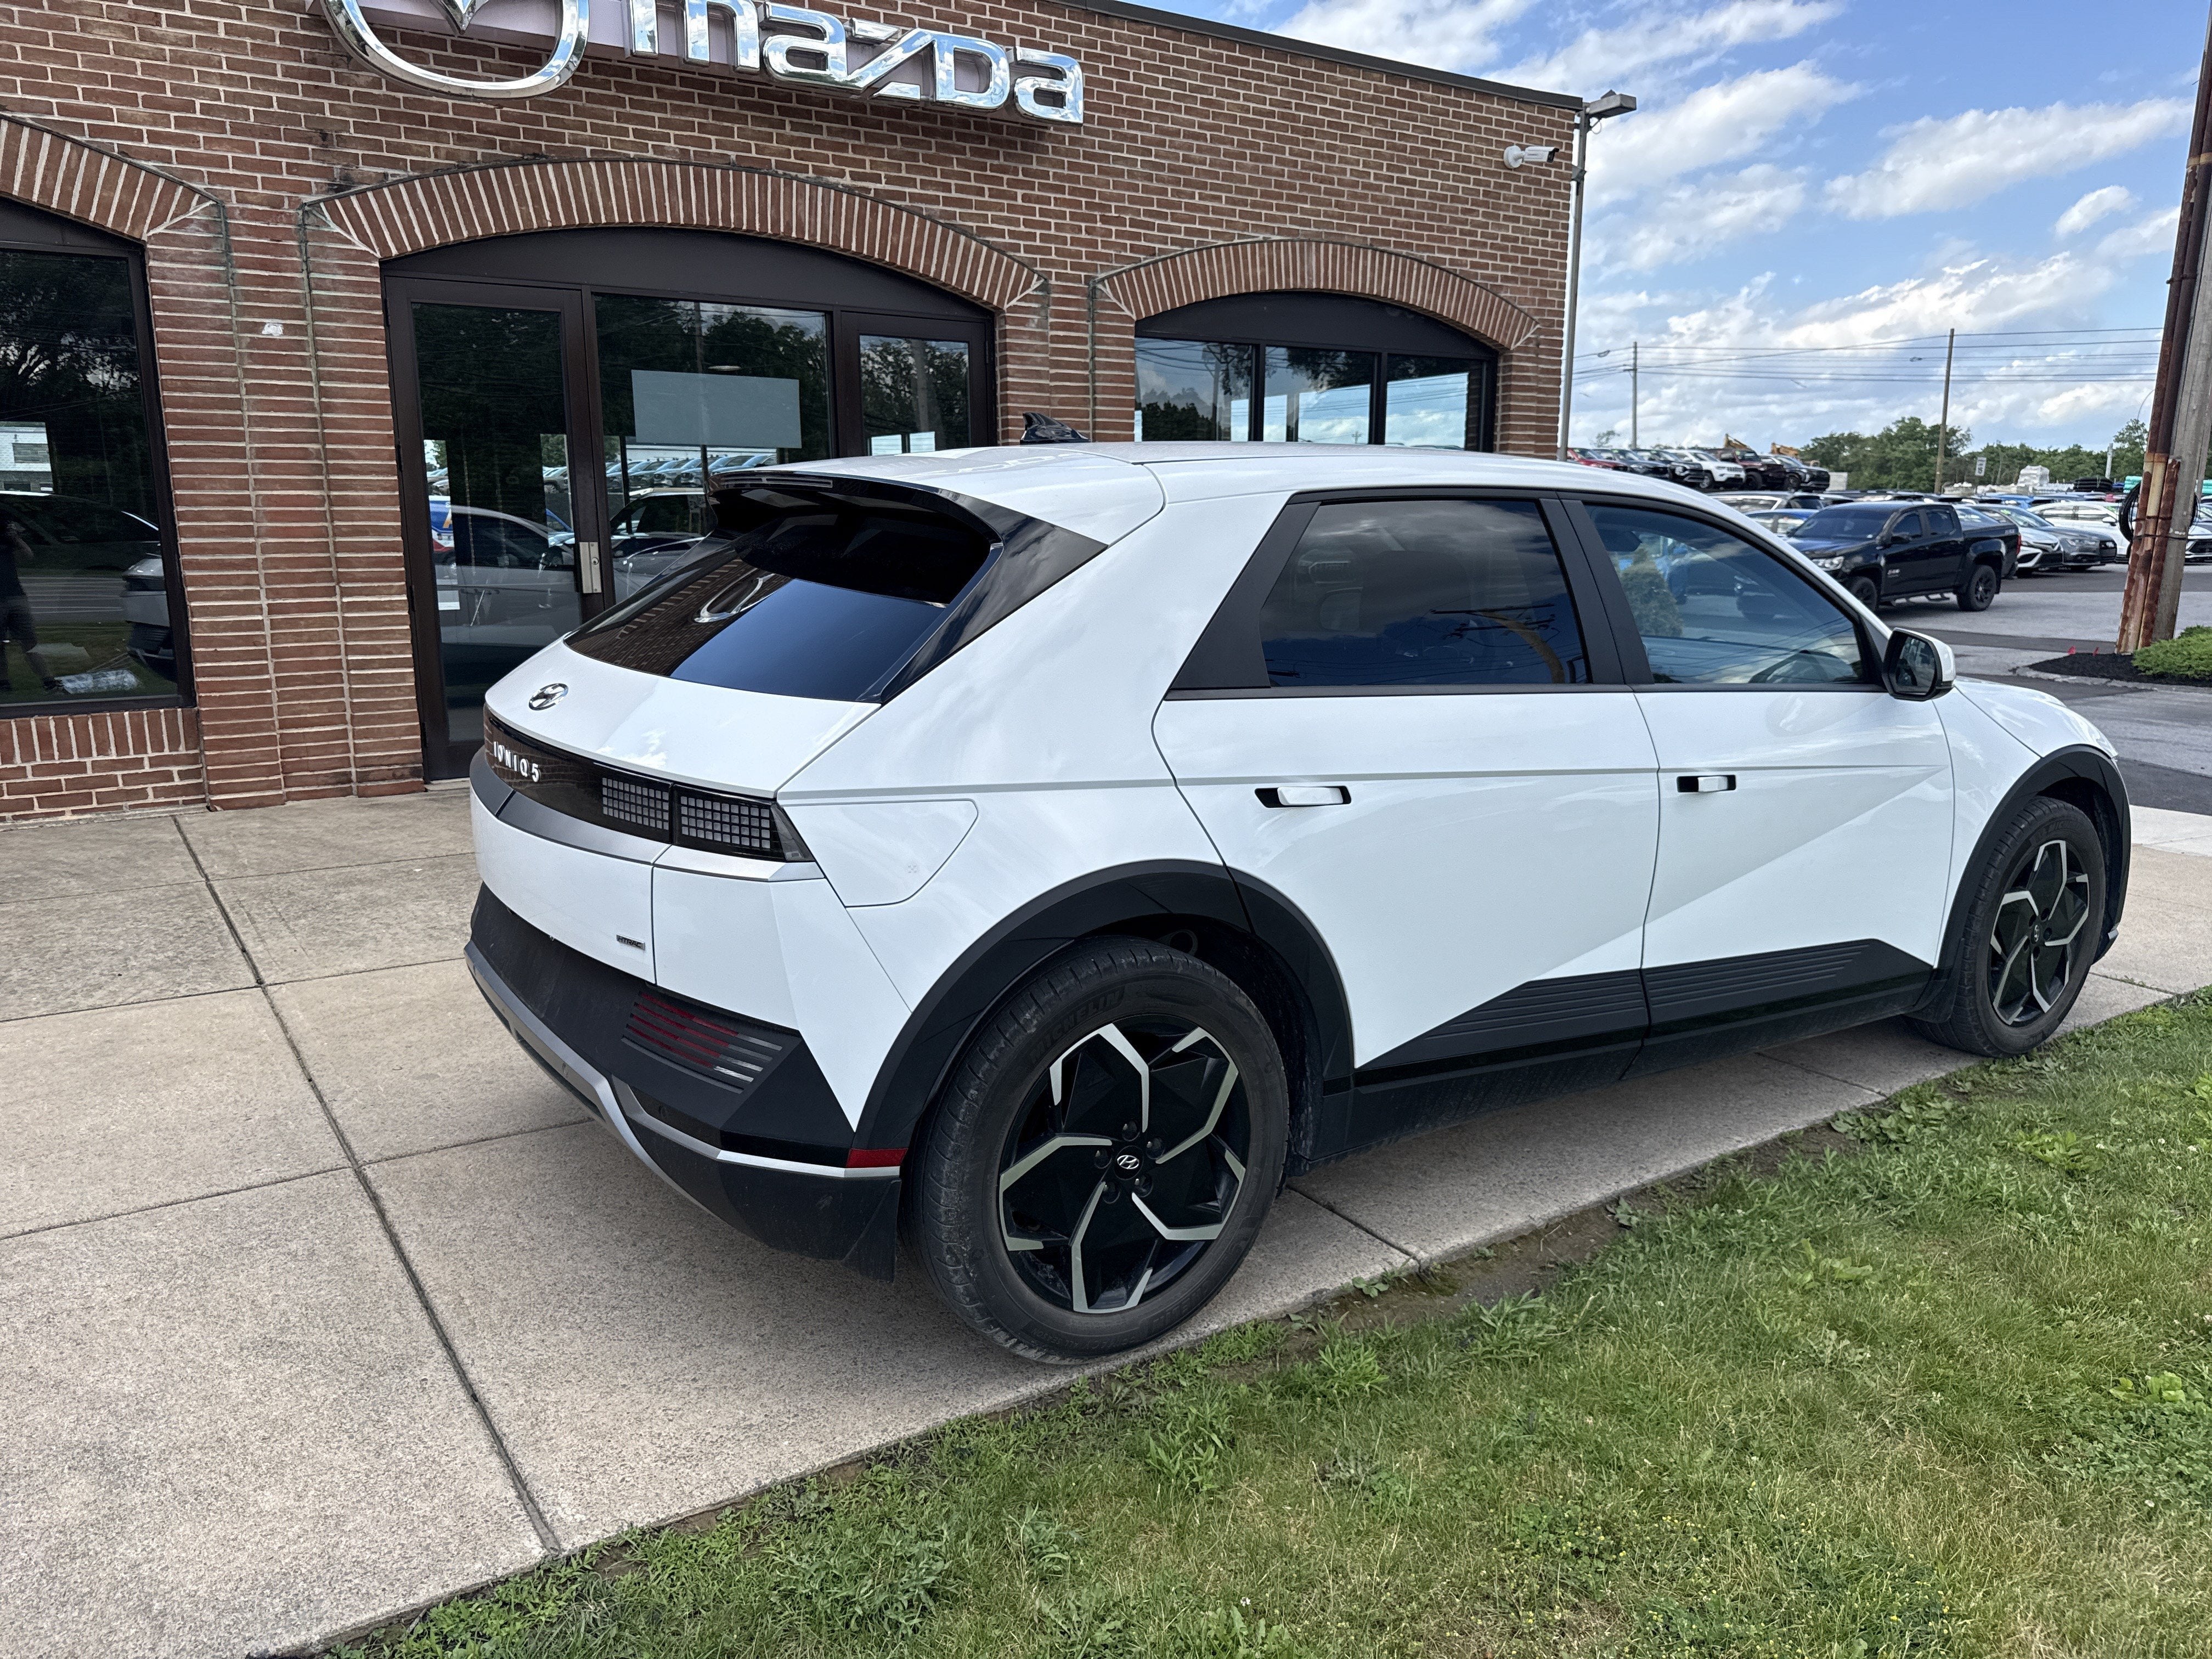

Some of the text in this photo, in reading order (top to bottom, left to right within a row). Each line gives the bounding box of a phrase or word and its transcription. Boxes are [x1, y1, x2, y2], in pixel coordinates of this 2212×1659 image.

[493, 741, 539, 782] IONIQ 5
[617, 935, 642, 949] HTRAC
[1029, 991, 1120, 1063] MICHELIN
